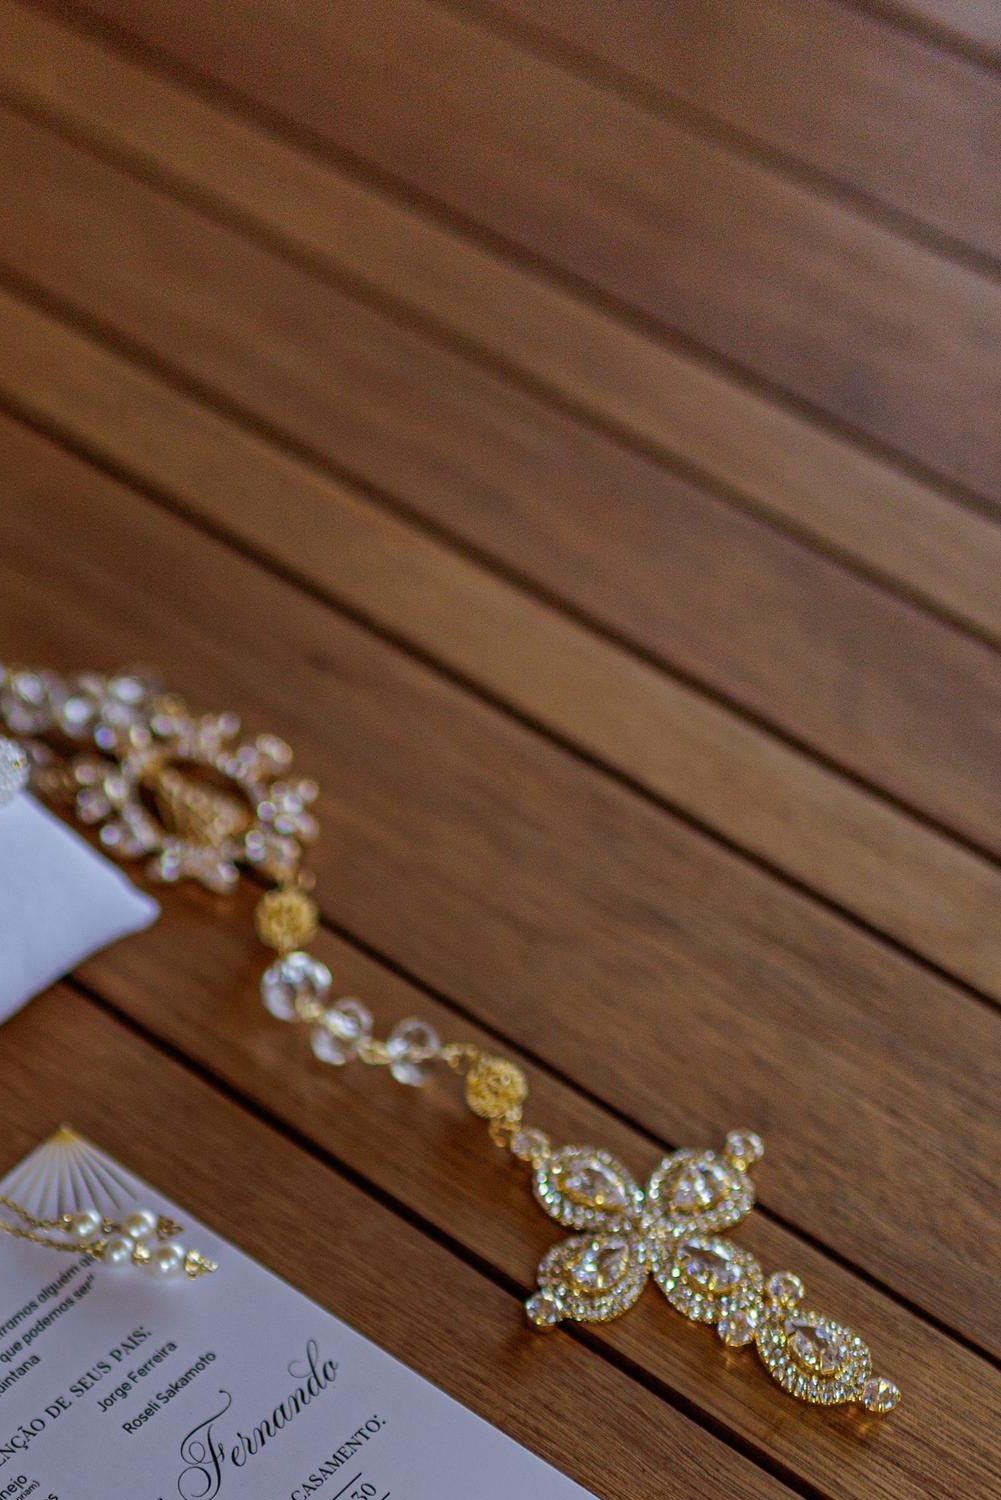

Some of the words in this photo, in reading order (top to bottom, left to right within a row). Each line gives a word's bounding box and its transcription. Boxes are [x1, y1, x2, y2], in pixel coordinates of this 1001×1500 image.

[35, 1263, 81, 1304] alguém
[20, 1295, 76, 1347] podemos
[43, 1395, 73, 1420] DE
[68, 1360, 112, 1398] SEUS
[107, 1325, 153, 1363] PAIS:
[95, 1380, 132, 1413] Jorge
[125, 1340, 178, 1384] Ferreira
[120, 1399, 161, 1435] Roseli
[154, 1351, 217, 1405] Sakamoto
